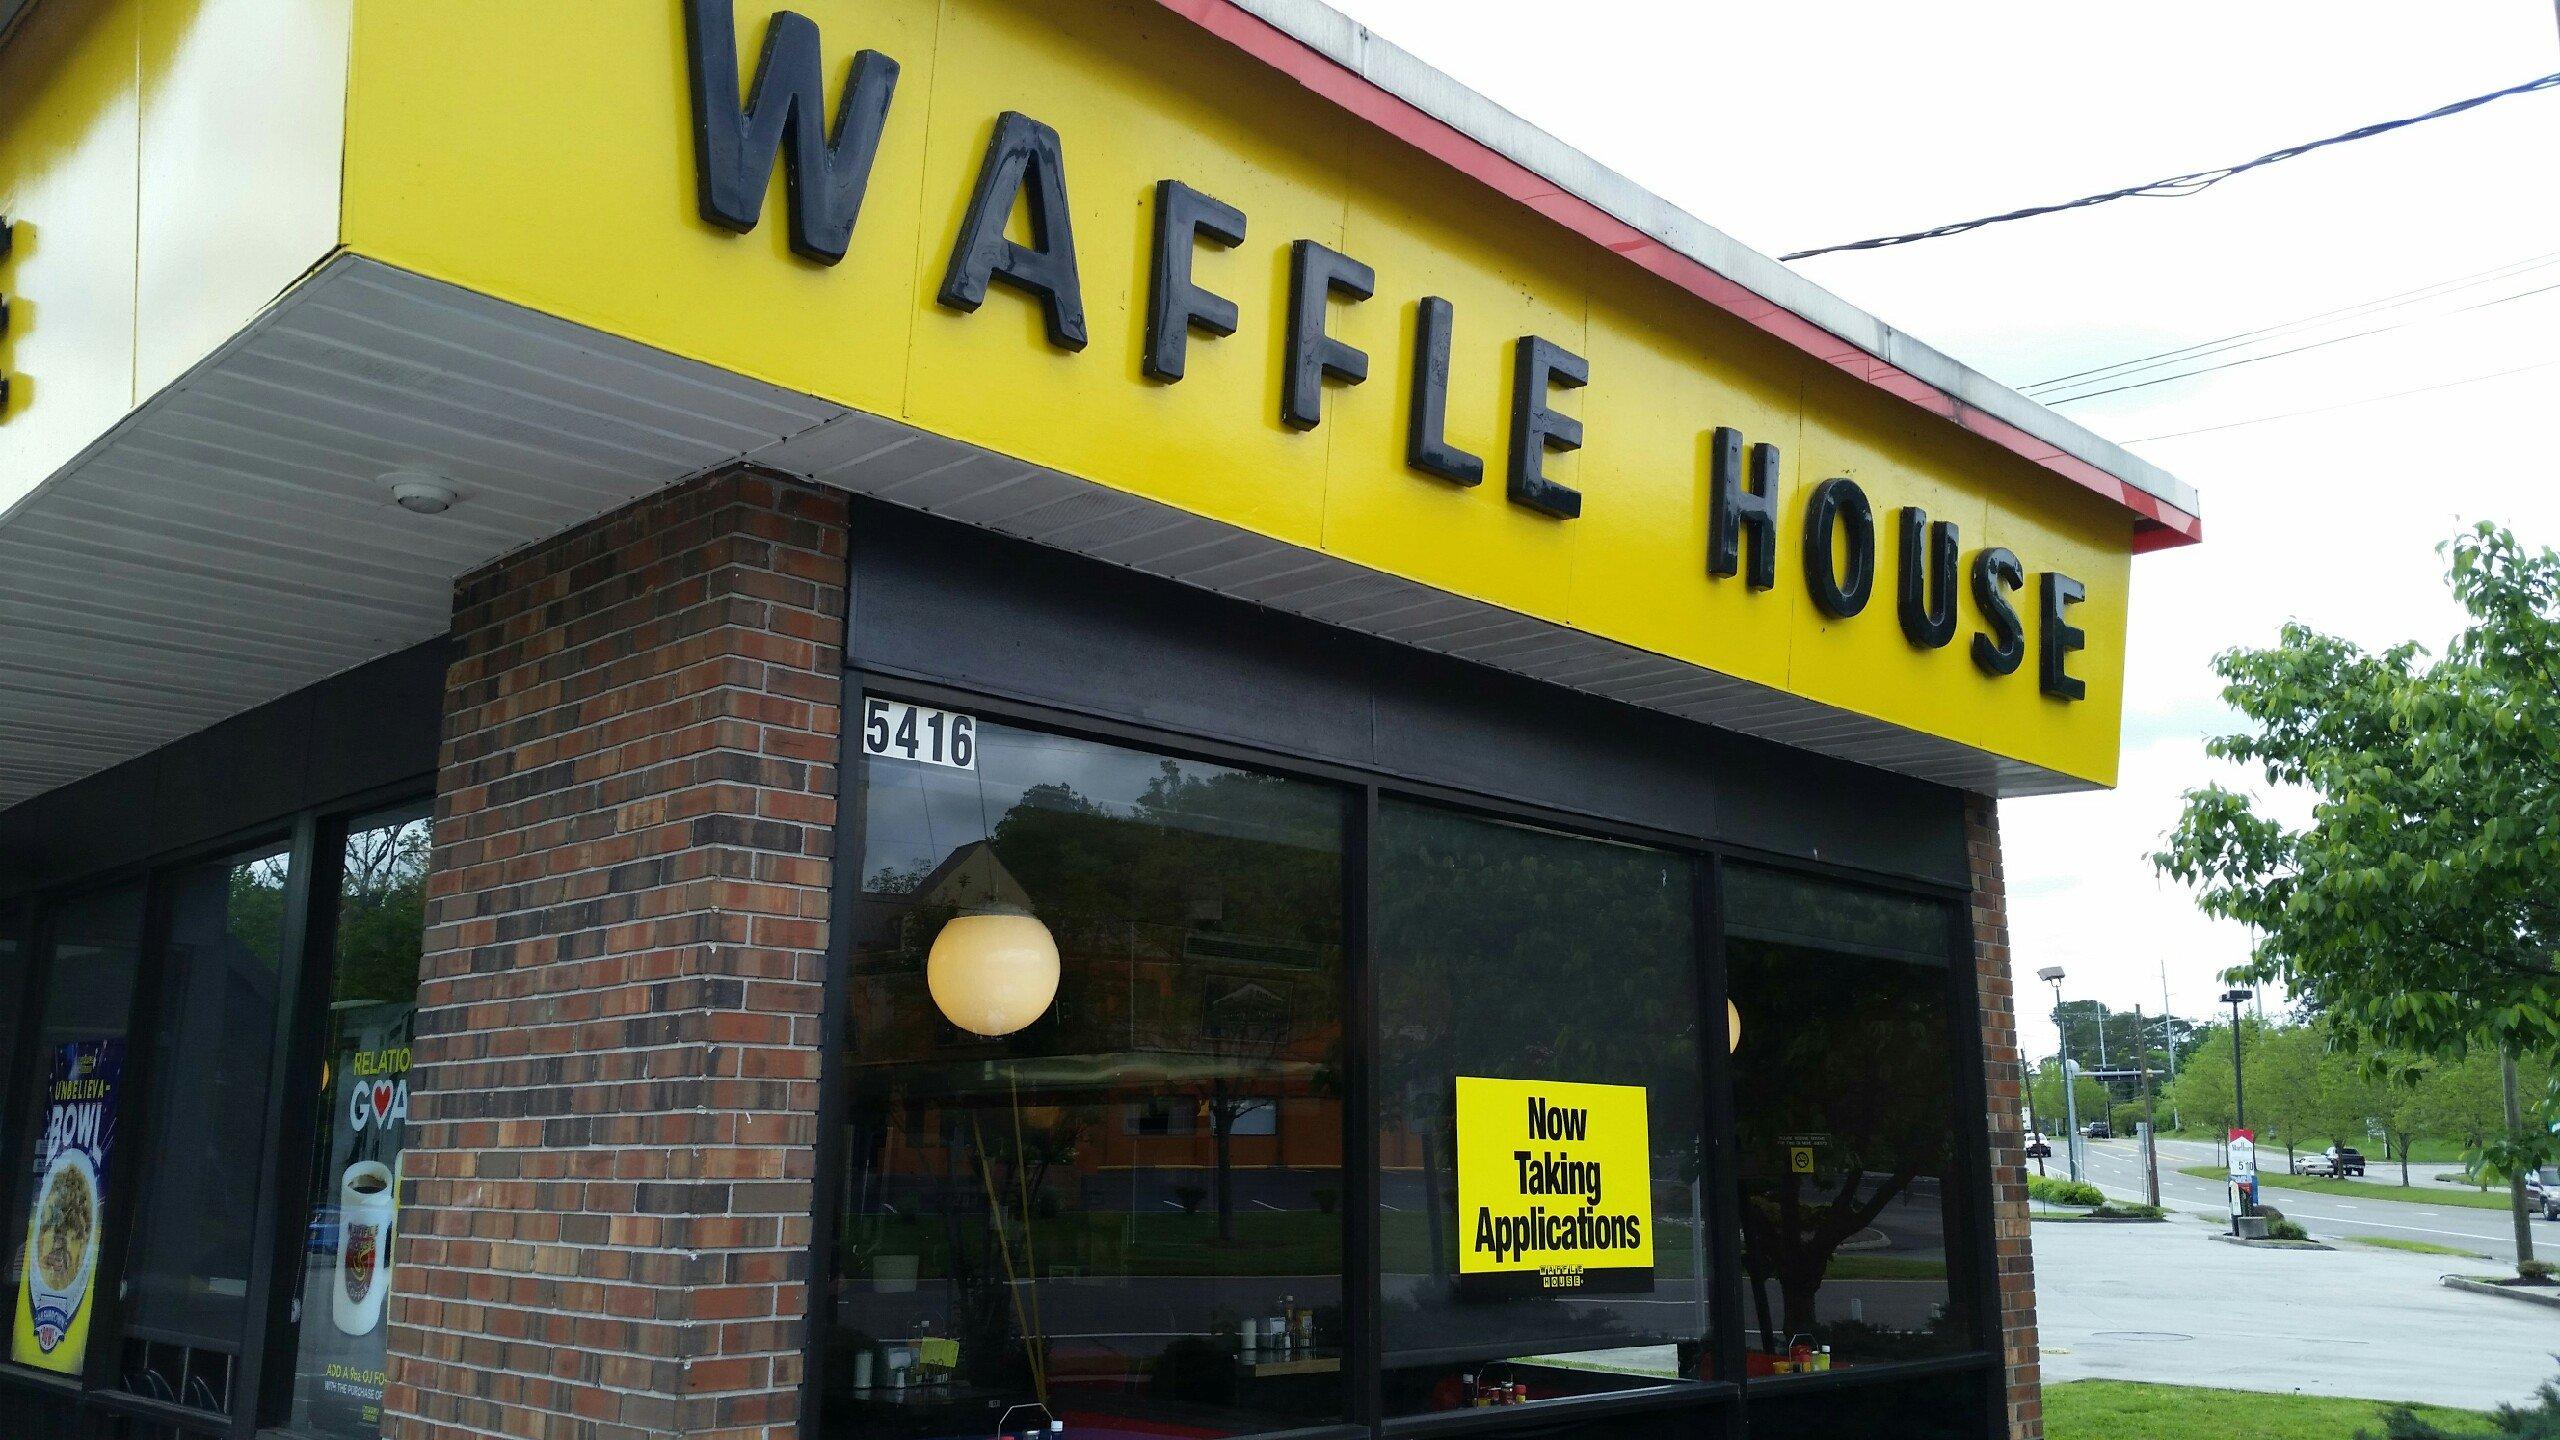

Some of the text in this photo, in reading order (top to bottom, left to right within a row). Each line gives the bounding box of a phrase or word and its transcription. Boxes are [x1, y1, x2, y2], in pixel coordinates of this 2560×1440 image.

[684, 0, 2085, 700] WAFFLE HOUSE
[867, 700, 973, 767] 5416
[353, 1048, 412, 1075] RELATIO
[45, 1102, 102, 1168] BOWL
[1528, 1097, 1587, 1141] Now
[1514, 1151, 1602, 1206] Taking
[1475, 1207, 1641, 1263] Applications
[1540, 1264, 1584, 1275] WAFFLE
[1544, 1276, 1580, 1287] HOUSE
[326, 1363, 341, 1377] ADD
[342, 1366, 349, 1379] A
